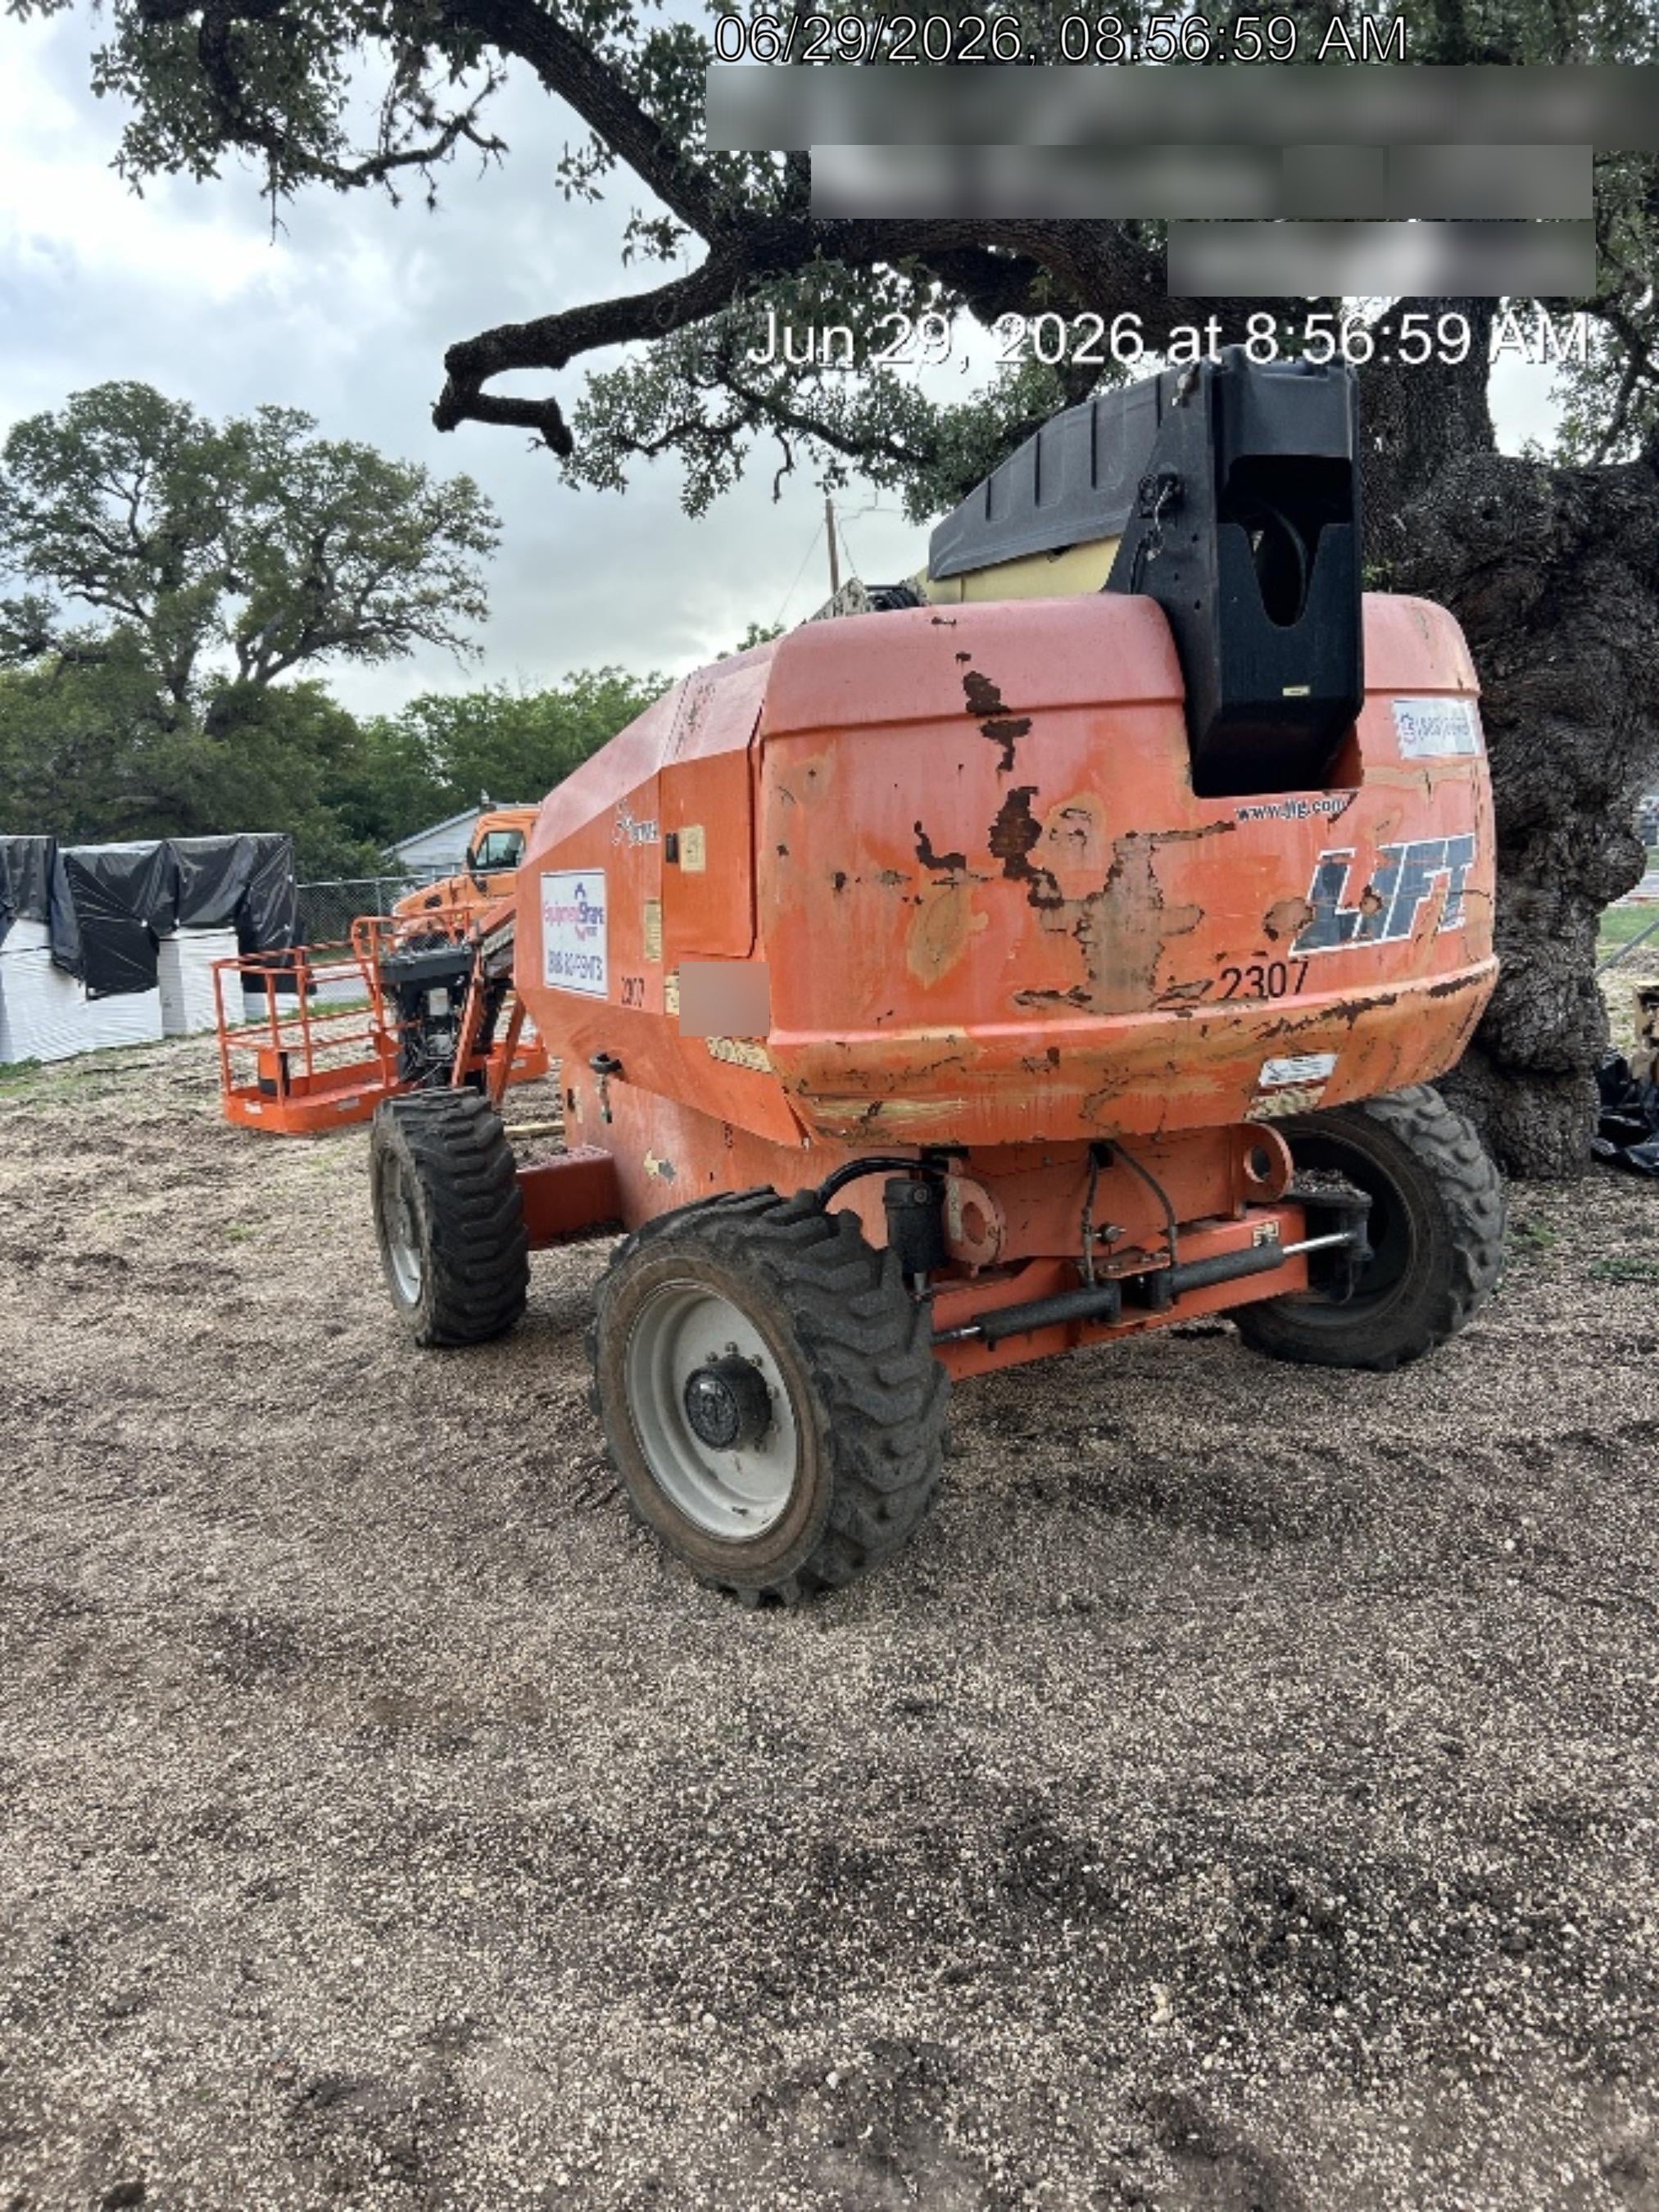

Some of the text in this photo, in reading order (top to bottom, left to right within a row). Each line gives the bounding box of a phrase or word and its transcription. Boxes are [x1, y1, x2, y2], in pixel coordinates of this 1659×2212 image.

[1235, 799, 1346, 820] www.jlg.com
[1288, 832, 1475, 957] LIFT
[1220, 960, 1310, 1000] 2307
